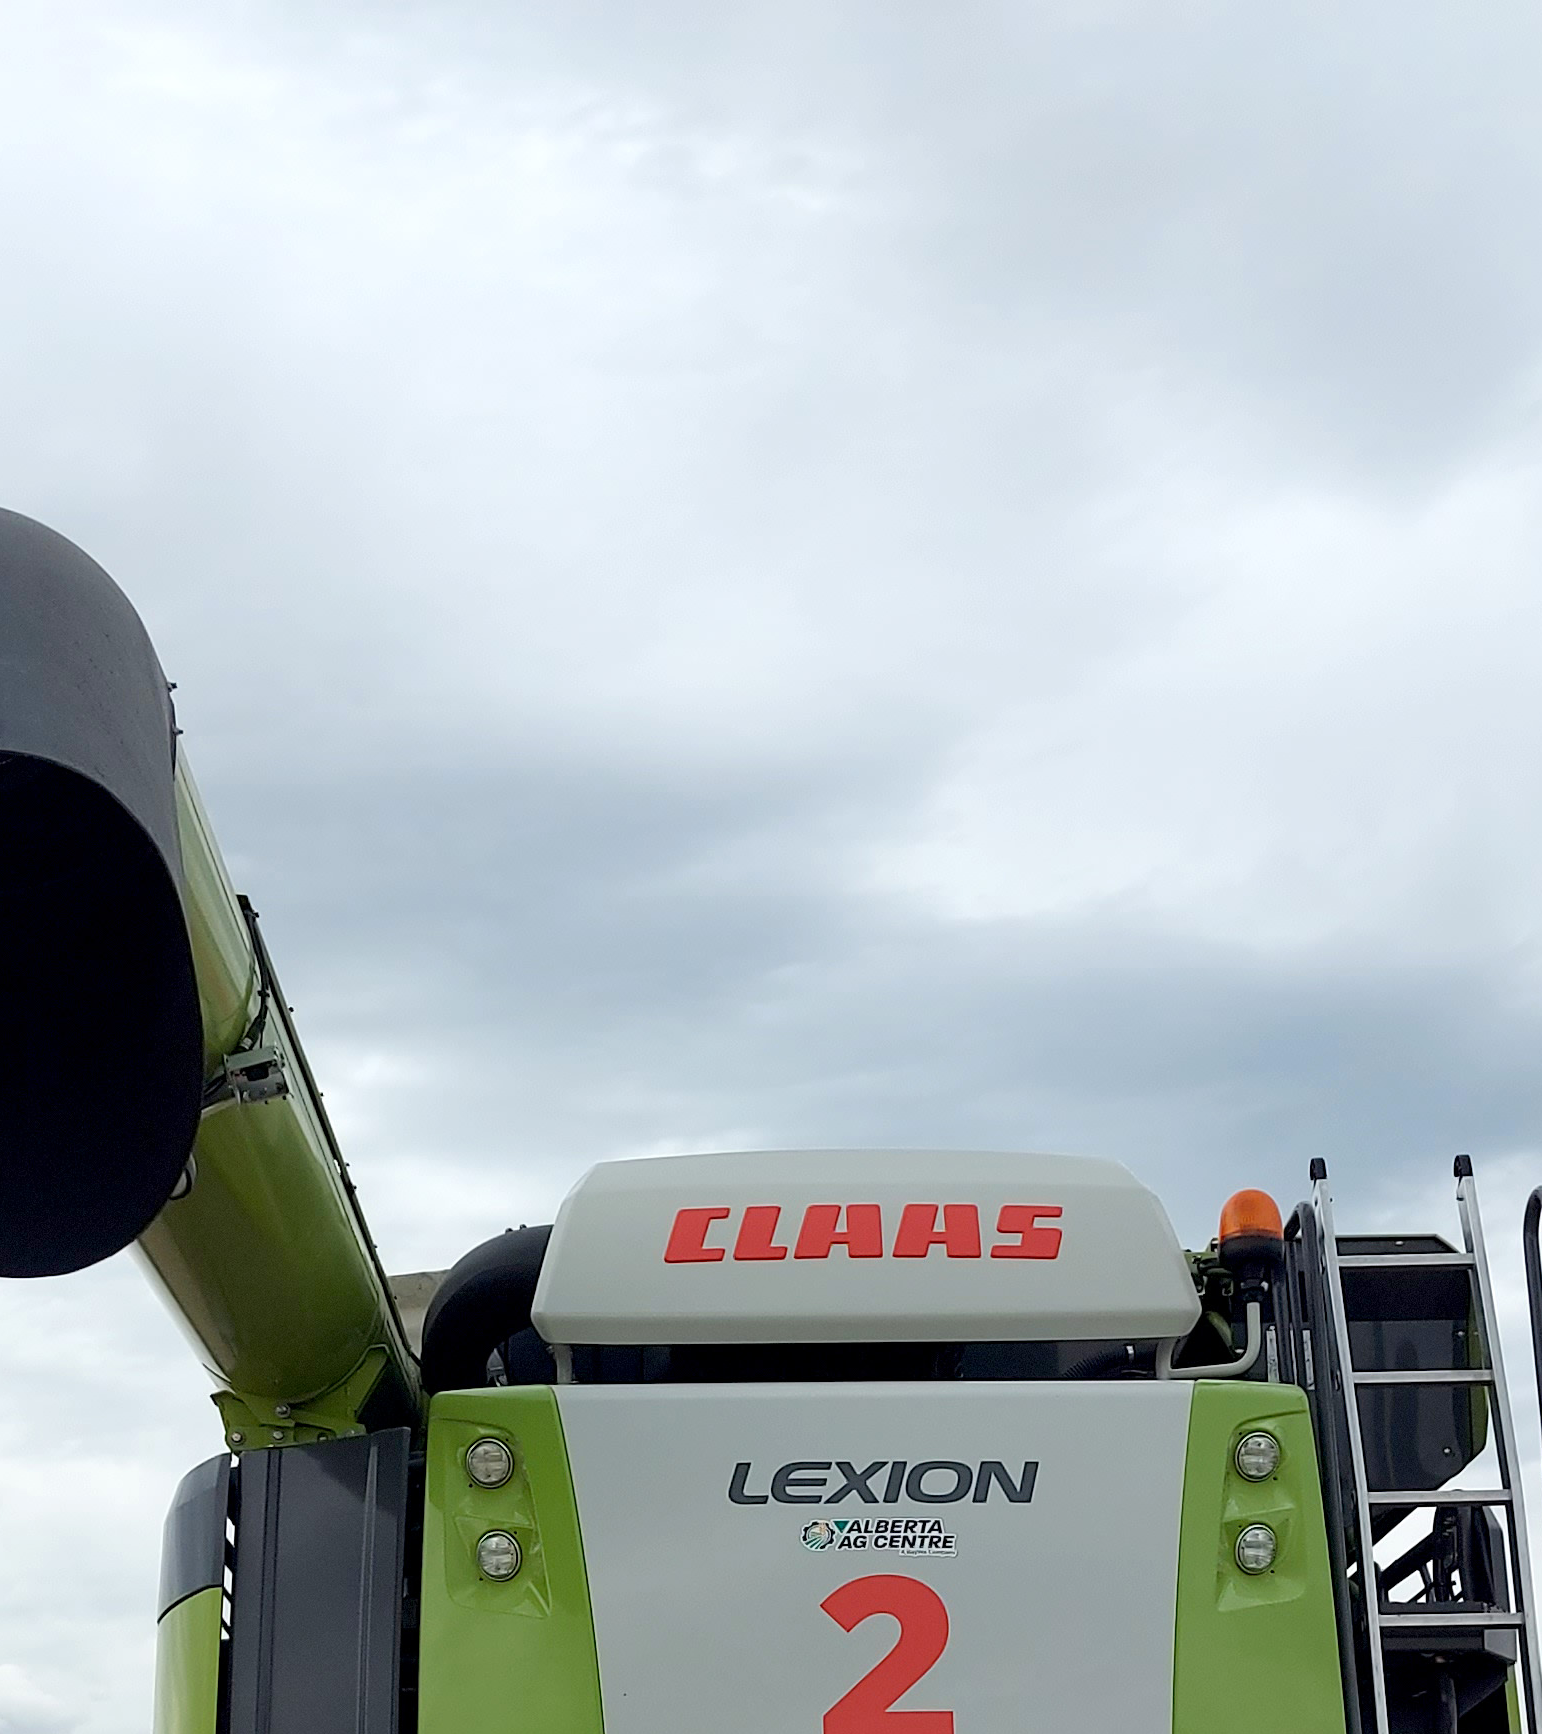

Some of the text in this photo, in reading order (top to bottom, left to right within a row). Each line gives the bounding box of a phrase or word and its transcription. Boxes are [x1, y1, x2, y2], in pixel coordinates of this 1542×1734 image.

[664, 1203, 1063, 1264] CLAAS
[728, 1460, 1040, 1505] LEXION
[846, 1519, 943, 1534] ALBERTA
[837, 1535, 955, 1549] AG CENTRE
